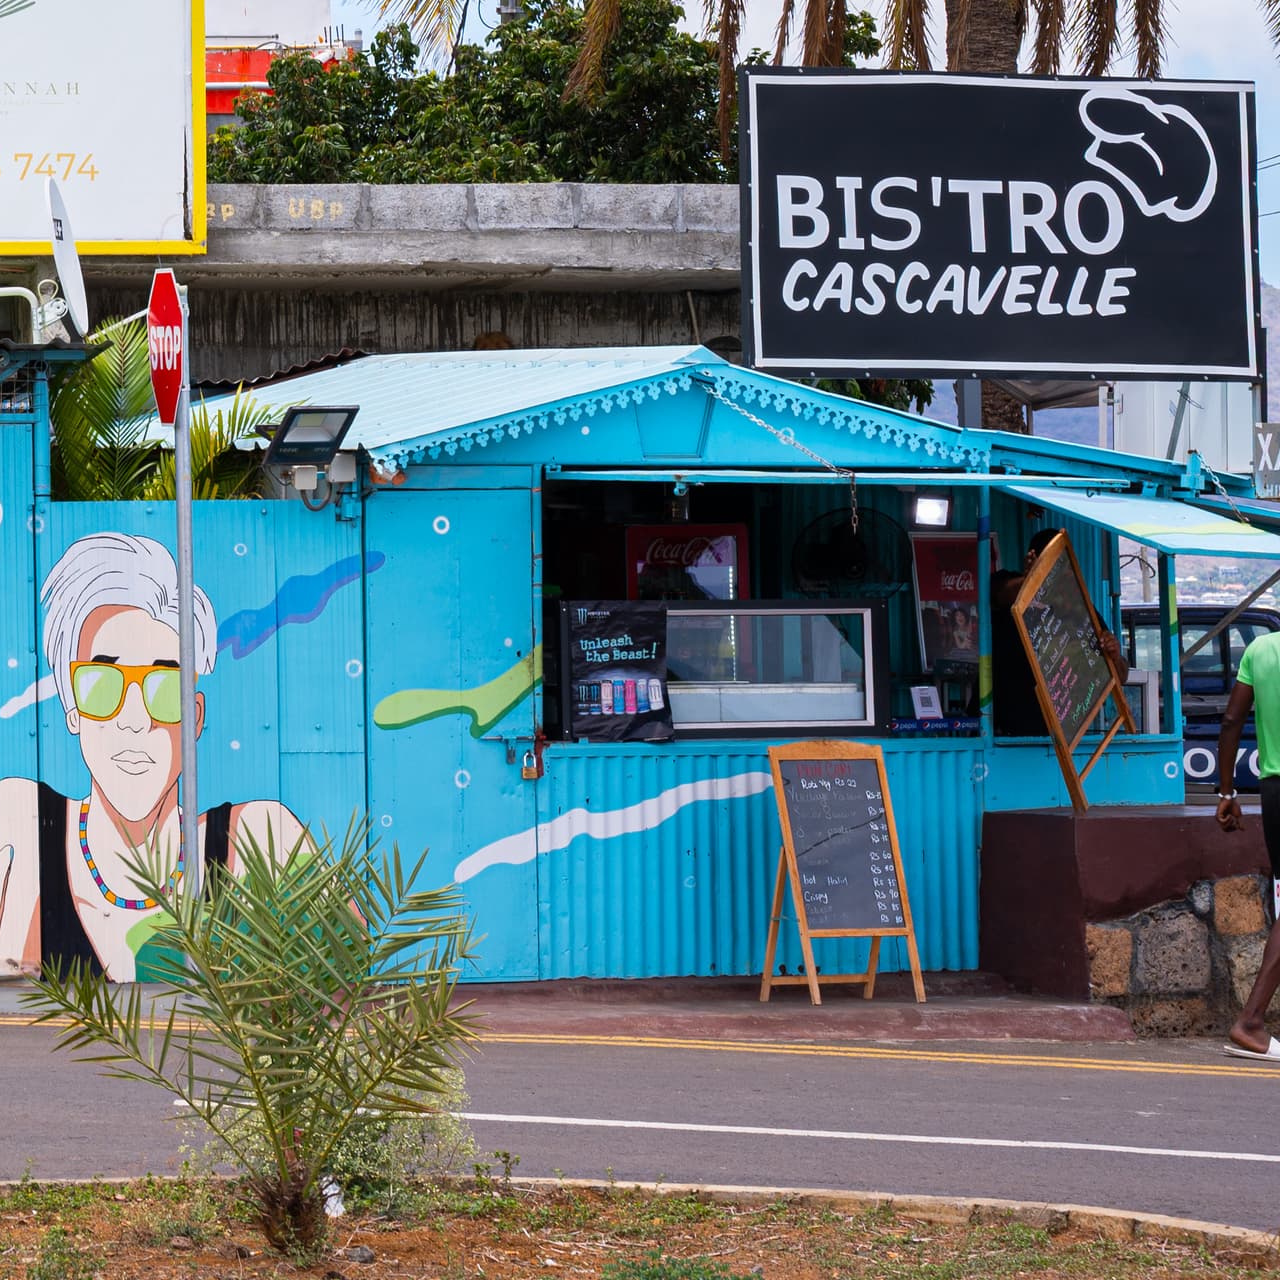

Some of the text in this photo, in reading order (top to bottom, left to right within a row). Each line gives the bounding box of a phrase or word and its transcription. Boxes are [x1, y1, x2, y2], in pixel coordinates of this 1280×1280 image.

[13, 152, 100, 181] 7474
[289, 197, 343, 221] UBP
[775, 174, 1125, 255] BIS'TRO
[782, 258, 1137, 318] CASCAVELLE
[150, 325, 181, 371] STOP
[580, 634, 633, 651] Unleash
[586, 650, 610, 662] the
